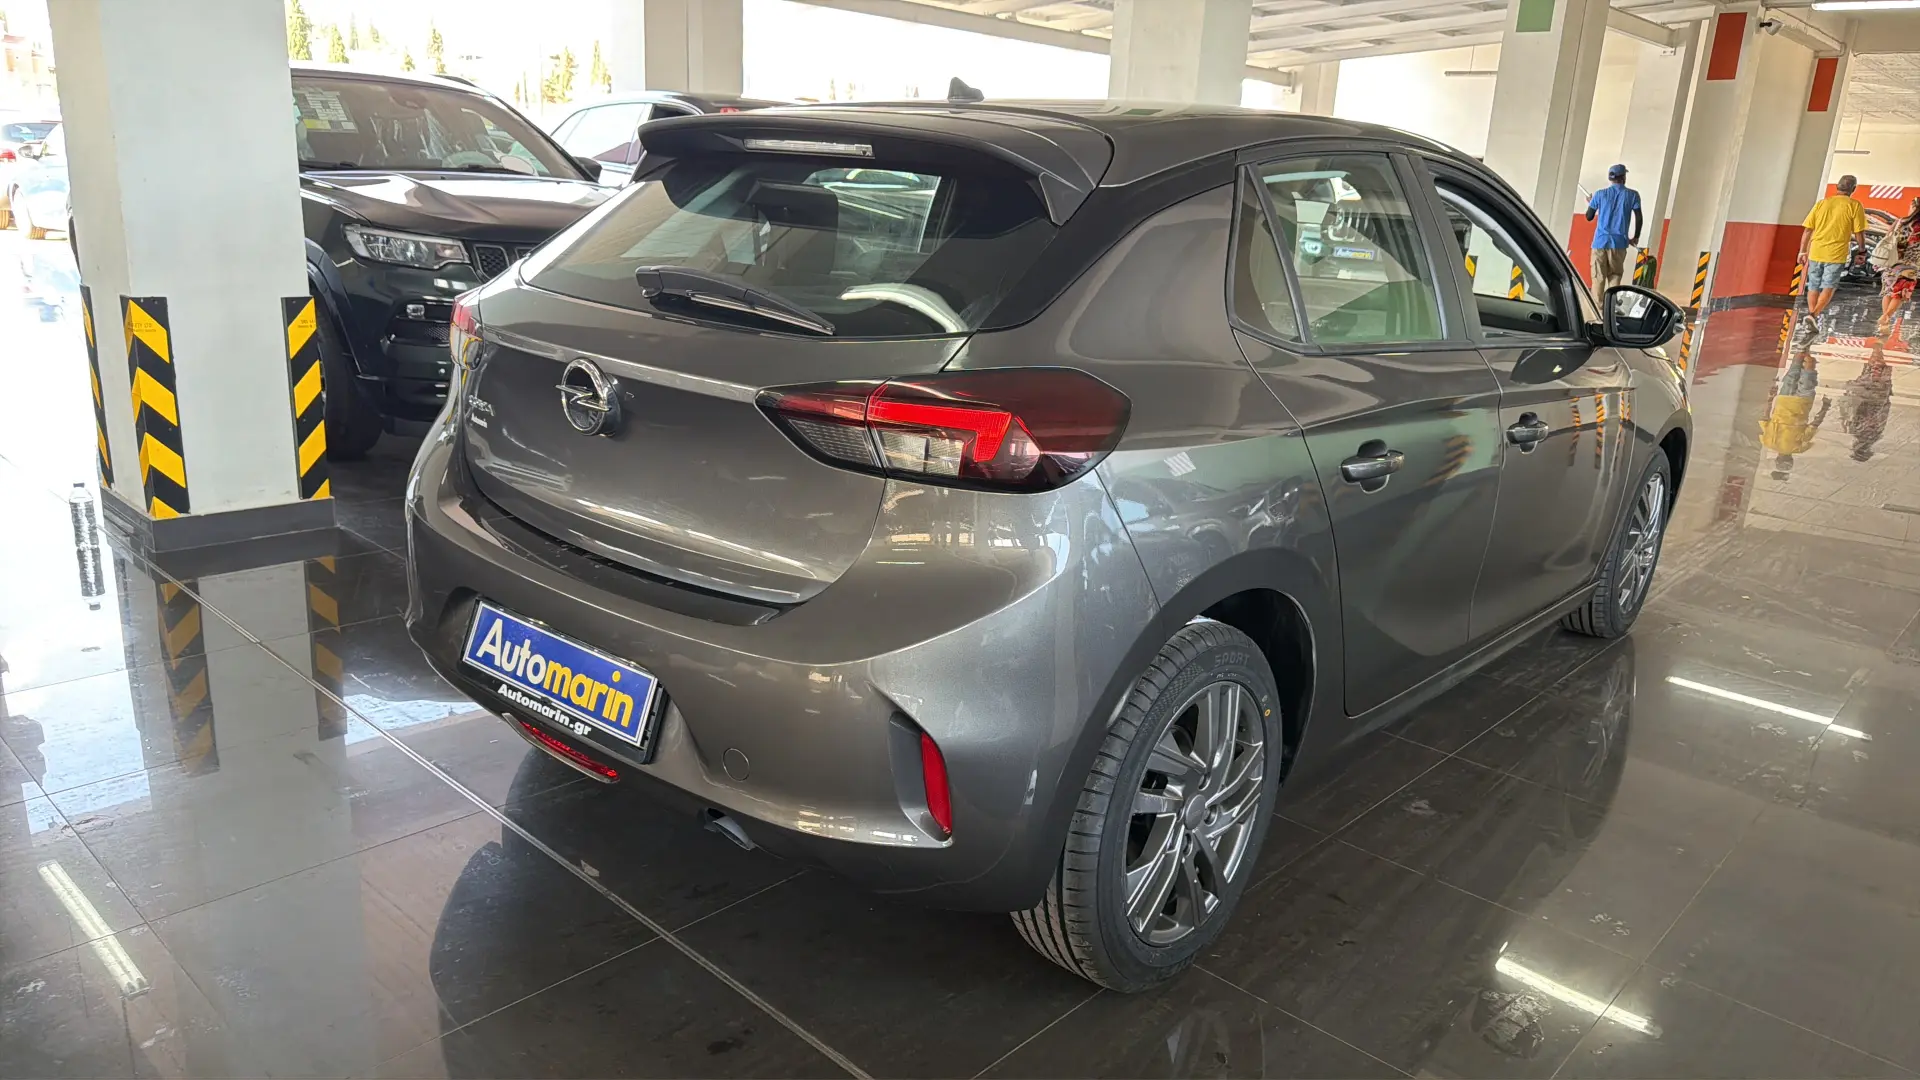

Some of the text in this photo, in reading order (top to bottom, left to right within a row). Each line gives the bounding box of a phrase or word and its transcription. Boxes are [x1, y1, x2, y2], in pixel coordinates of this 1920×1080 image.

[476, 618, 634, 727] Automarin
[1214, 652, 1250, 667] SPORT
[497, 684, 592, 736] Automarin.gr
